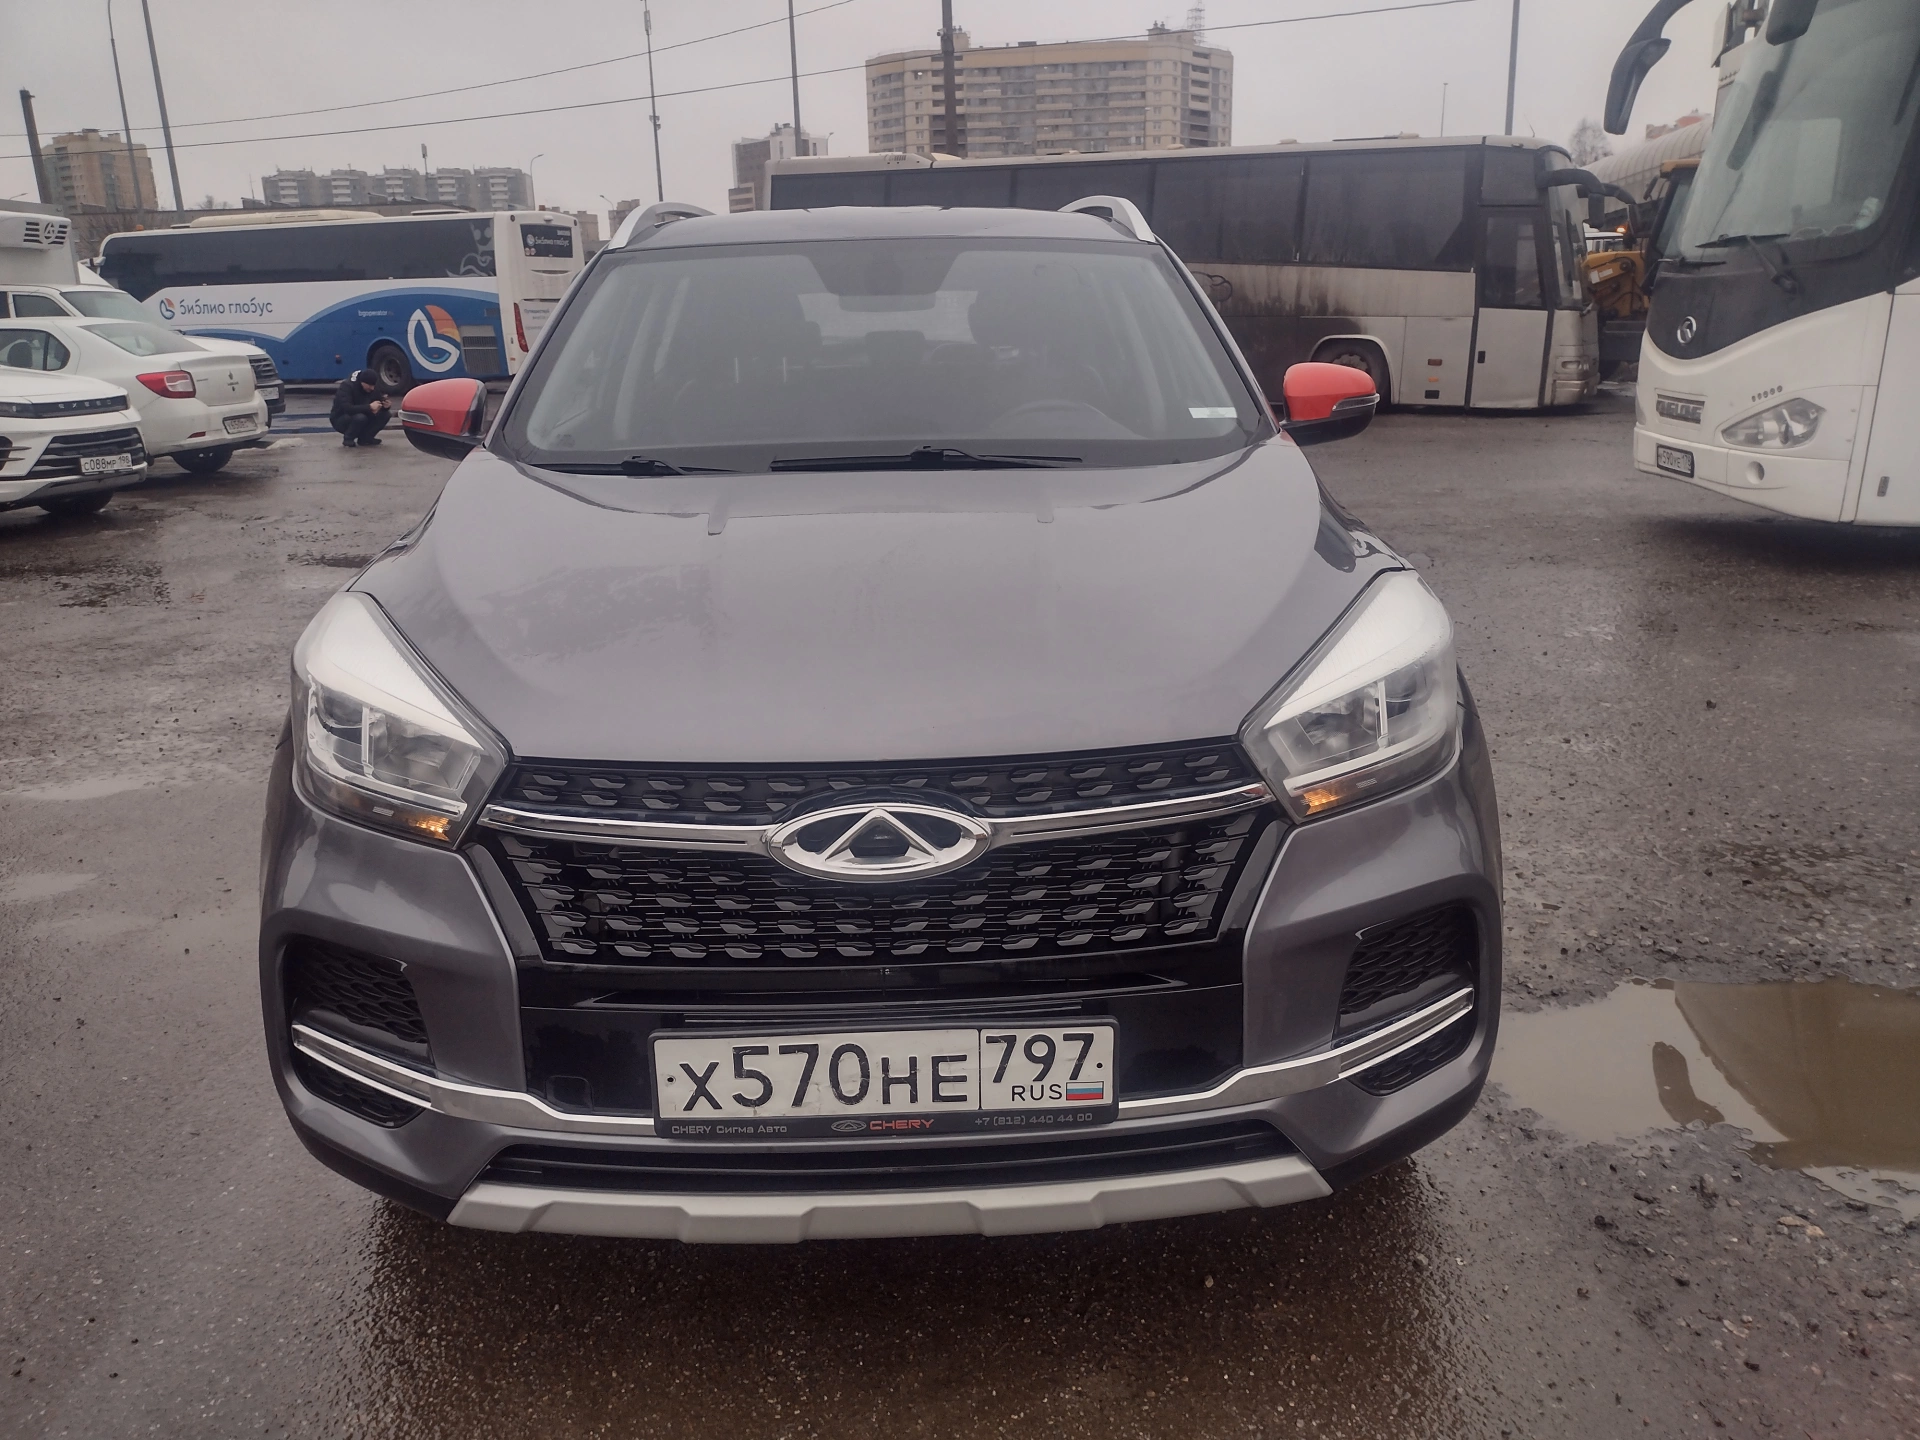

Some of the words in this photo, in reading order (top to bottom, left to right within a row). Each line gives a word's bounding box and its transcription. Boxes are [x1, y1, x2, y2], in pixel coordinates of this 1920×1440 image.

[179, 298, 226, 315] библио
[228, 297, 273, 317] глобус
[679, 1043, 968, 1111] Х570НЕ
[985, 1033, 1095, 1083] 797
[1011, 1083, 1063, 1102] RUS
[869, 1118, 934, 1131] CHERY
[974, 1116, 990, 1126] +7
[993, 1115, 1026, 1127] (812)
[1029, 1114, 1053, 1125] 440
[1057, 1113, 1074, 1124] 44
[1076, 1112, 1093, 1123] 00
[671, 1125, 712, 1134] CHERY
[716, 1125, 754, 1134] Сигма
[757, 1124, 787, 1133] Авто
